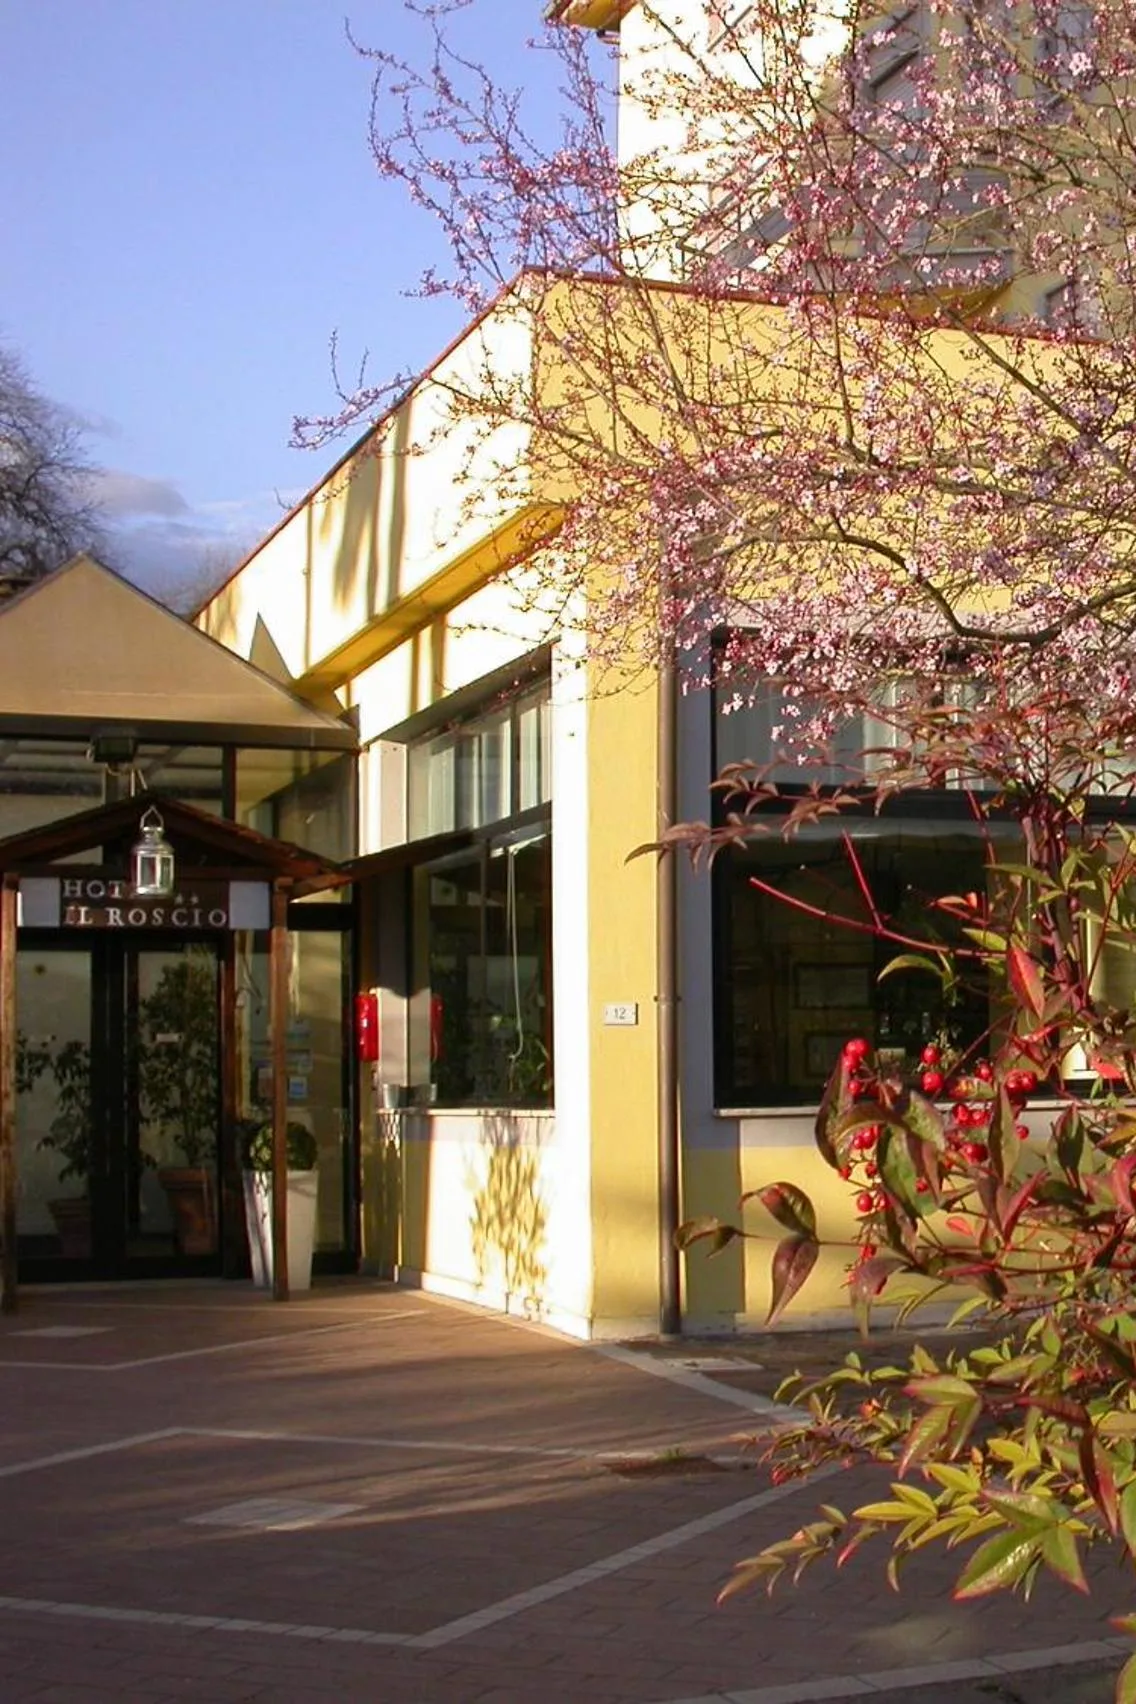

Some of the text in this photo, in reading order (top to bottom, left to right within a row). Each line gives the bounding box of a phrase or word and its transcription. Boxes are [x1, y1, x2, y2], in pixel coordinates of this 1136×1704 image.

[63, 879, 141, 899] HOT
[64, 905, 227, 928] IL ROSCIO
